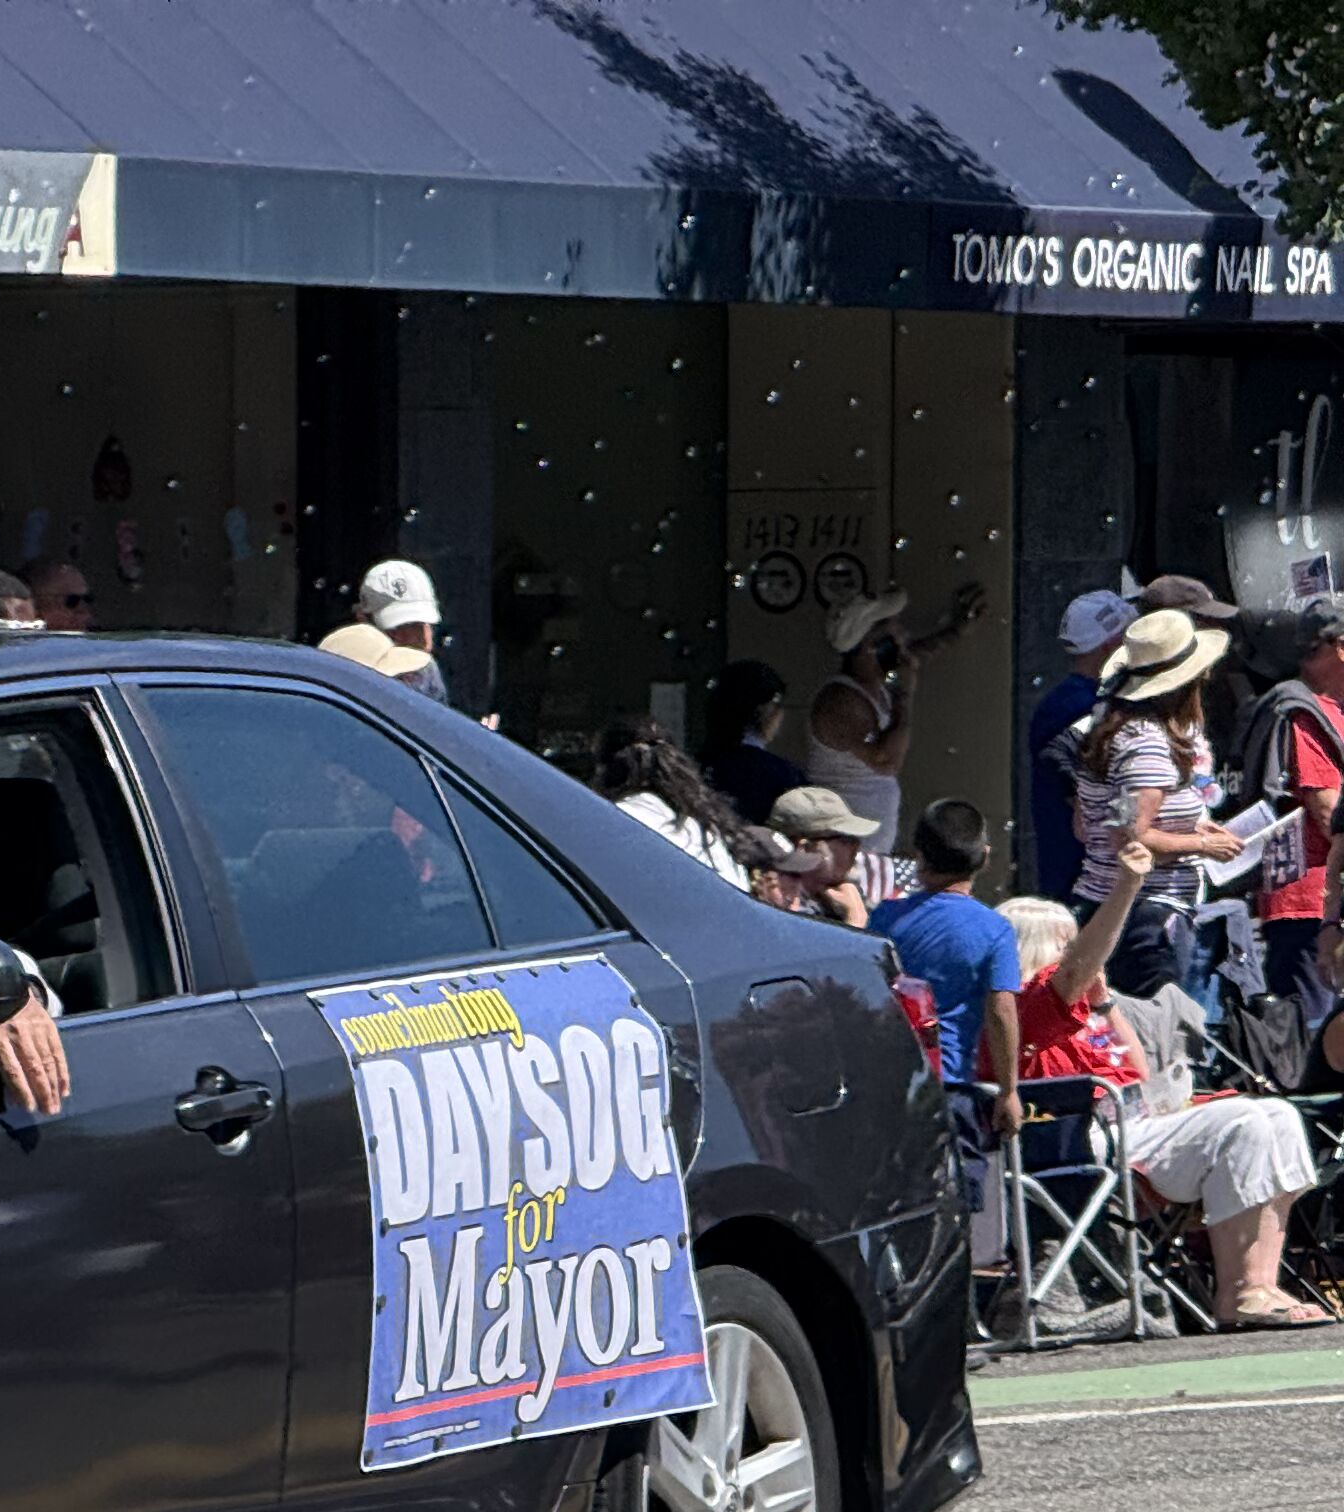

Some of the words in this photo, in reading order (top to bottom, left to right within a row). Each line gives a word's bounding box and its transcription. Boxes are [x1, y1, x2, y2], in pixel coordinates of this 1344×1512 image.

[952, 232, 1063, 287] TOMO'S
[1072, 236, 1203, 292] ORGANIC
[1215, 245, 1276, 294] NAIL
[1286, 245, 1334, 295] SPA
[438, 985, 524, 1049] tony
[361, 1018, 672, 1226] DAYSOG
[496, 1180, 566, 1285] for
[392, 1224, 673, 1423] Mayor
